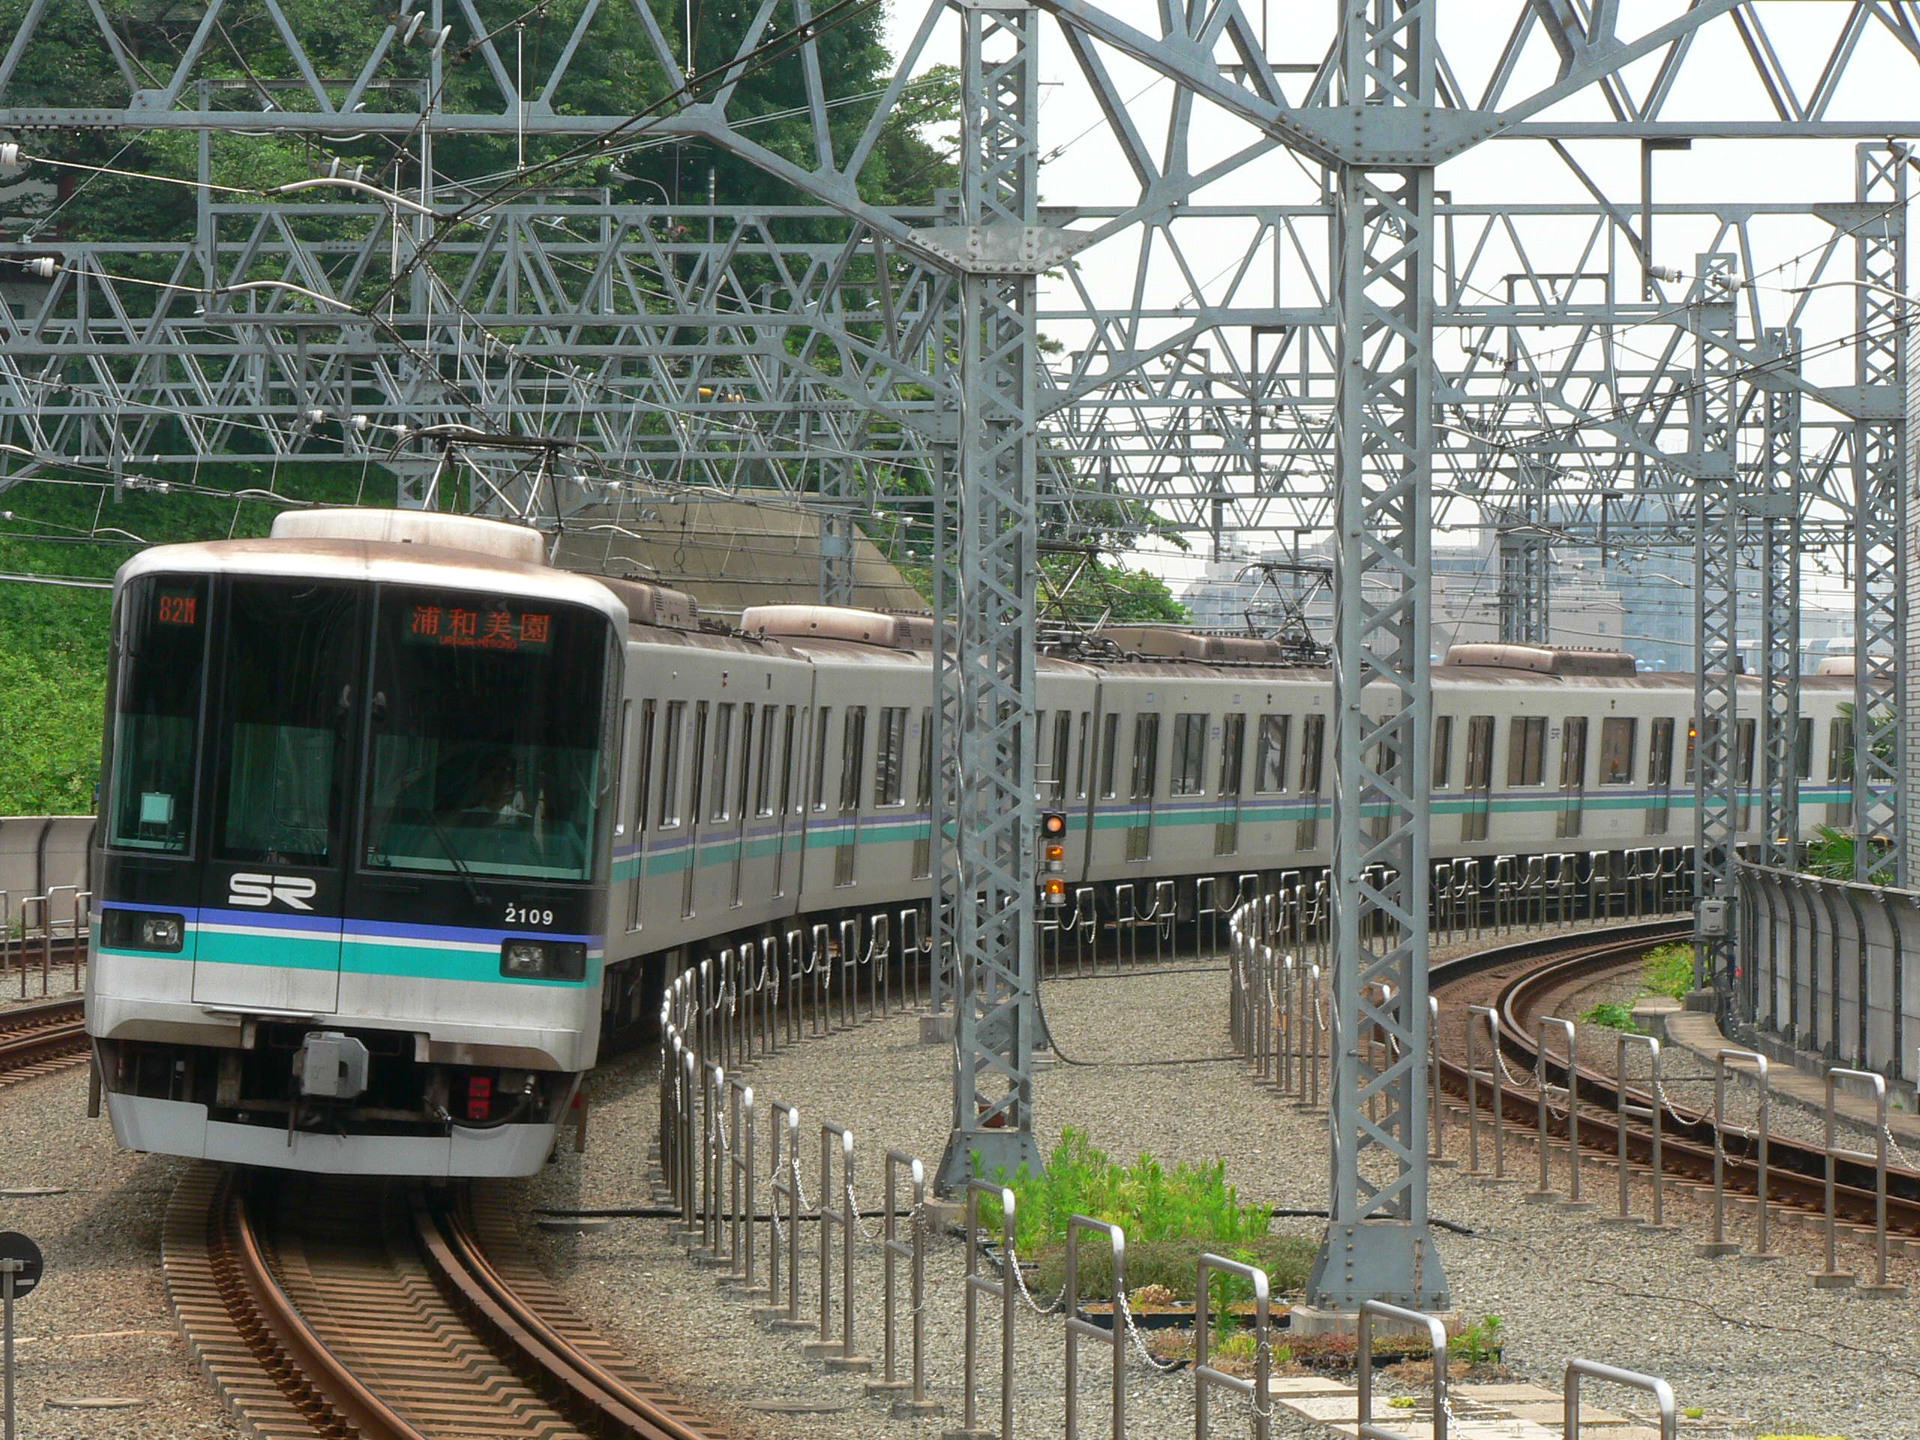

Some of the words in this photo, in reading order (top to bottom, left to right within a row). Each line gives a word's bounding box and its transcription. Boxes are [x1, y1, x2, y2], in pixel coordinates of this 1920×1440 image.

[411, 604, 551, 643] 浦和美園
[228, 872, 317, 911] SR
[505, 907, 554, 926] 2109
